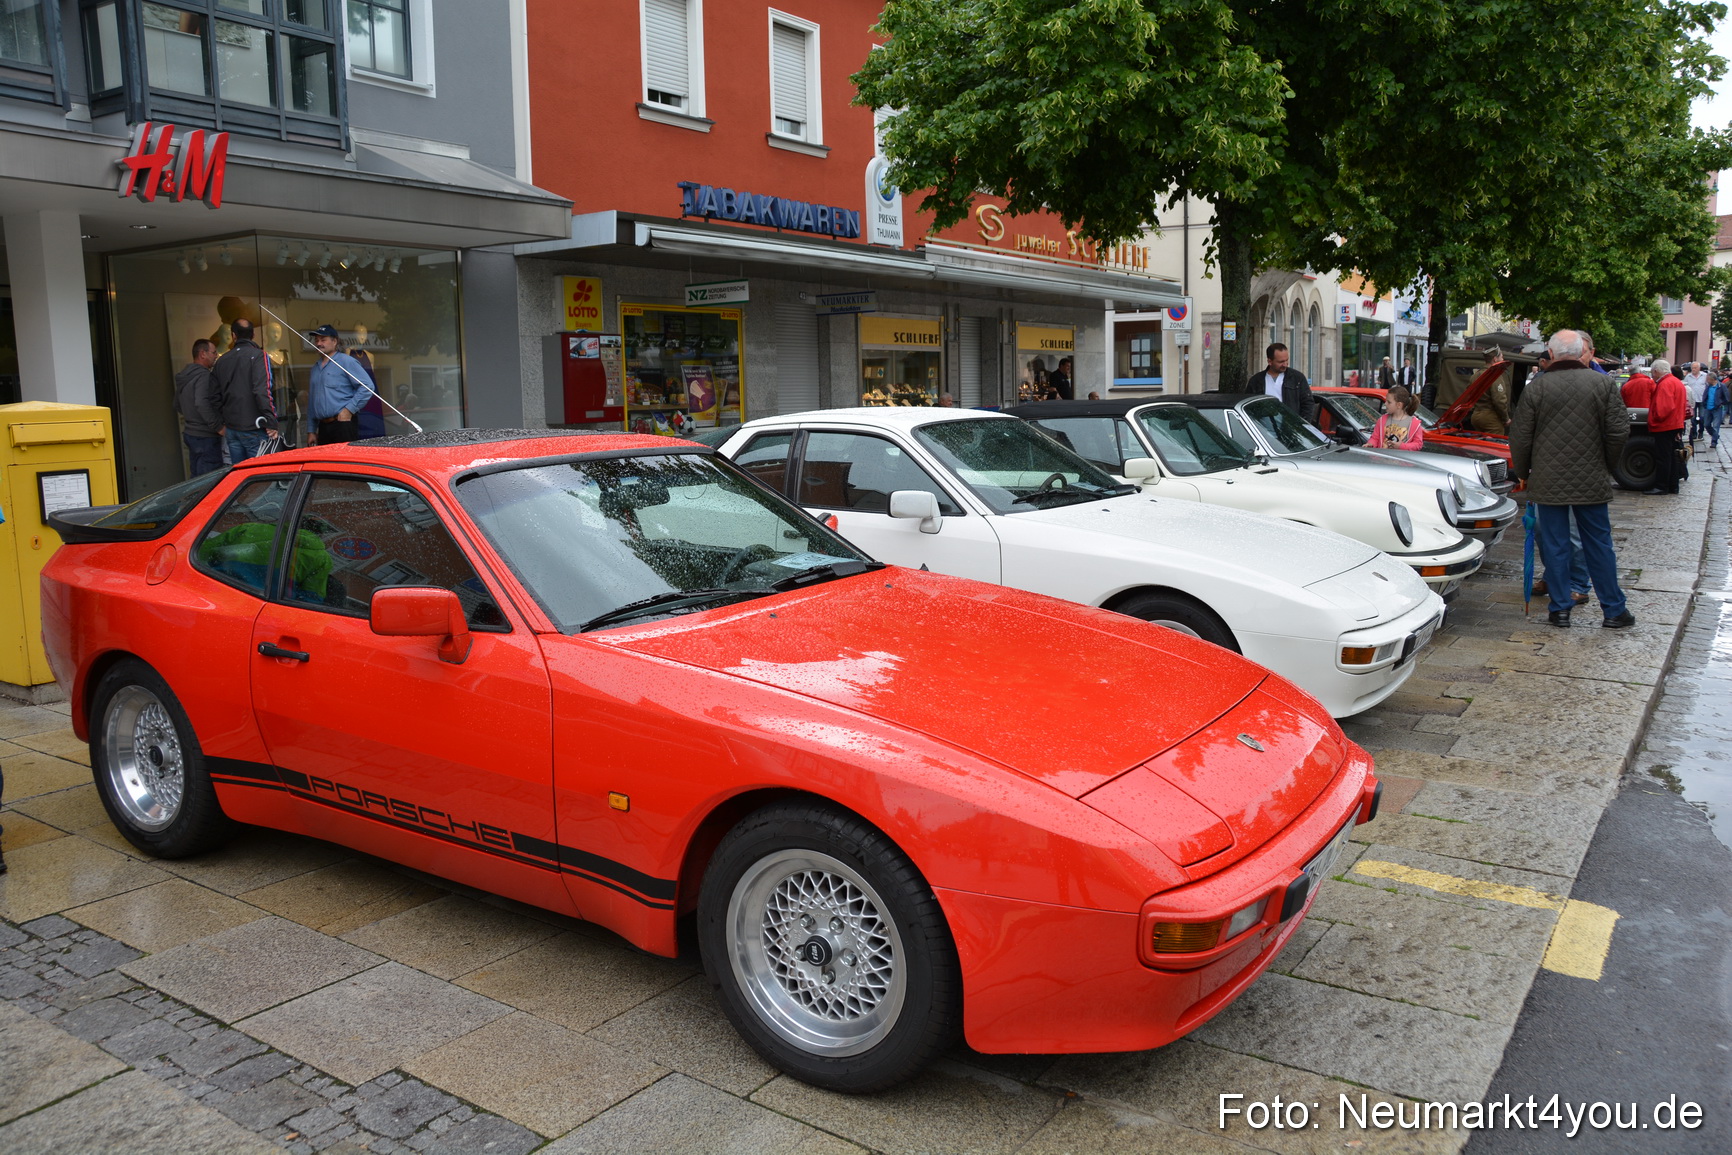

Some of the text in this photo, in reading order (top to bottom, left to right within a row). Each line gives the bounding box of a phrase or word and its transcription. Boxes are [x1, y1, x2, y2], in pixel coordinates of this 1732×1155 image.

[116, 121, 230, 209] H&M
[677, 181, 860, 239] TABAKWAREN
[878, 213, 898, 226] PRESSE
[877, 227, 901, 240] THUMANN
[688, 289, 708, 301] NZ
[708, 285, 746, 294] NORDBAYERISCHE
[821, 295, 869, 306] NEUMARKTER
[568, 306, 598, 318] LOTTO
[894, 332, 940, 344] SCHLIERF
[1040, 339, 1073, 349] SCHLIERF
[308, 775, 513, 849] PORSCHE
